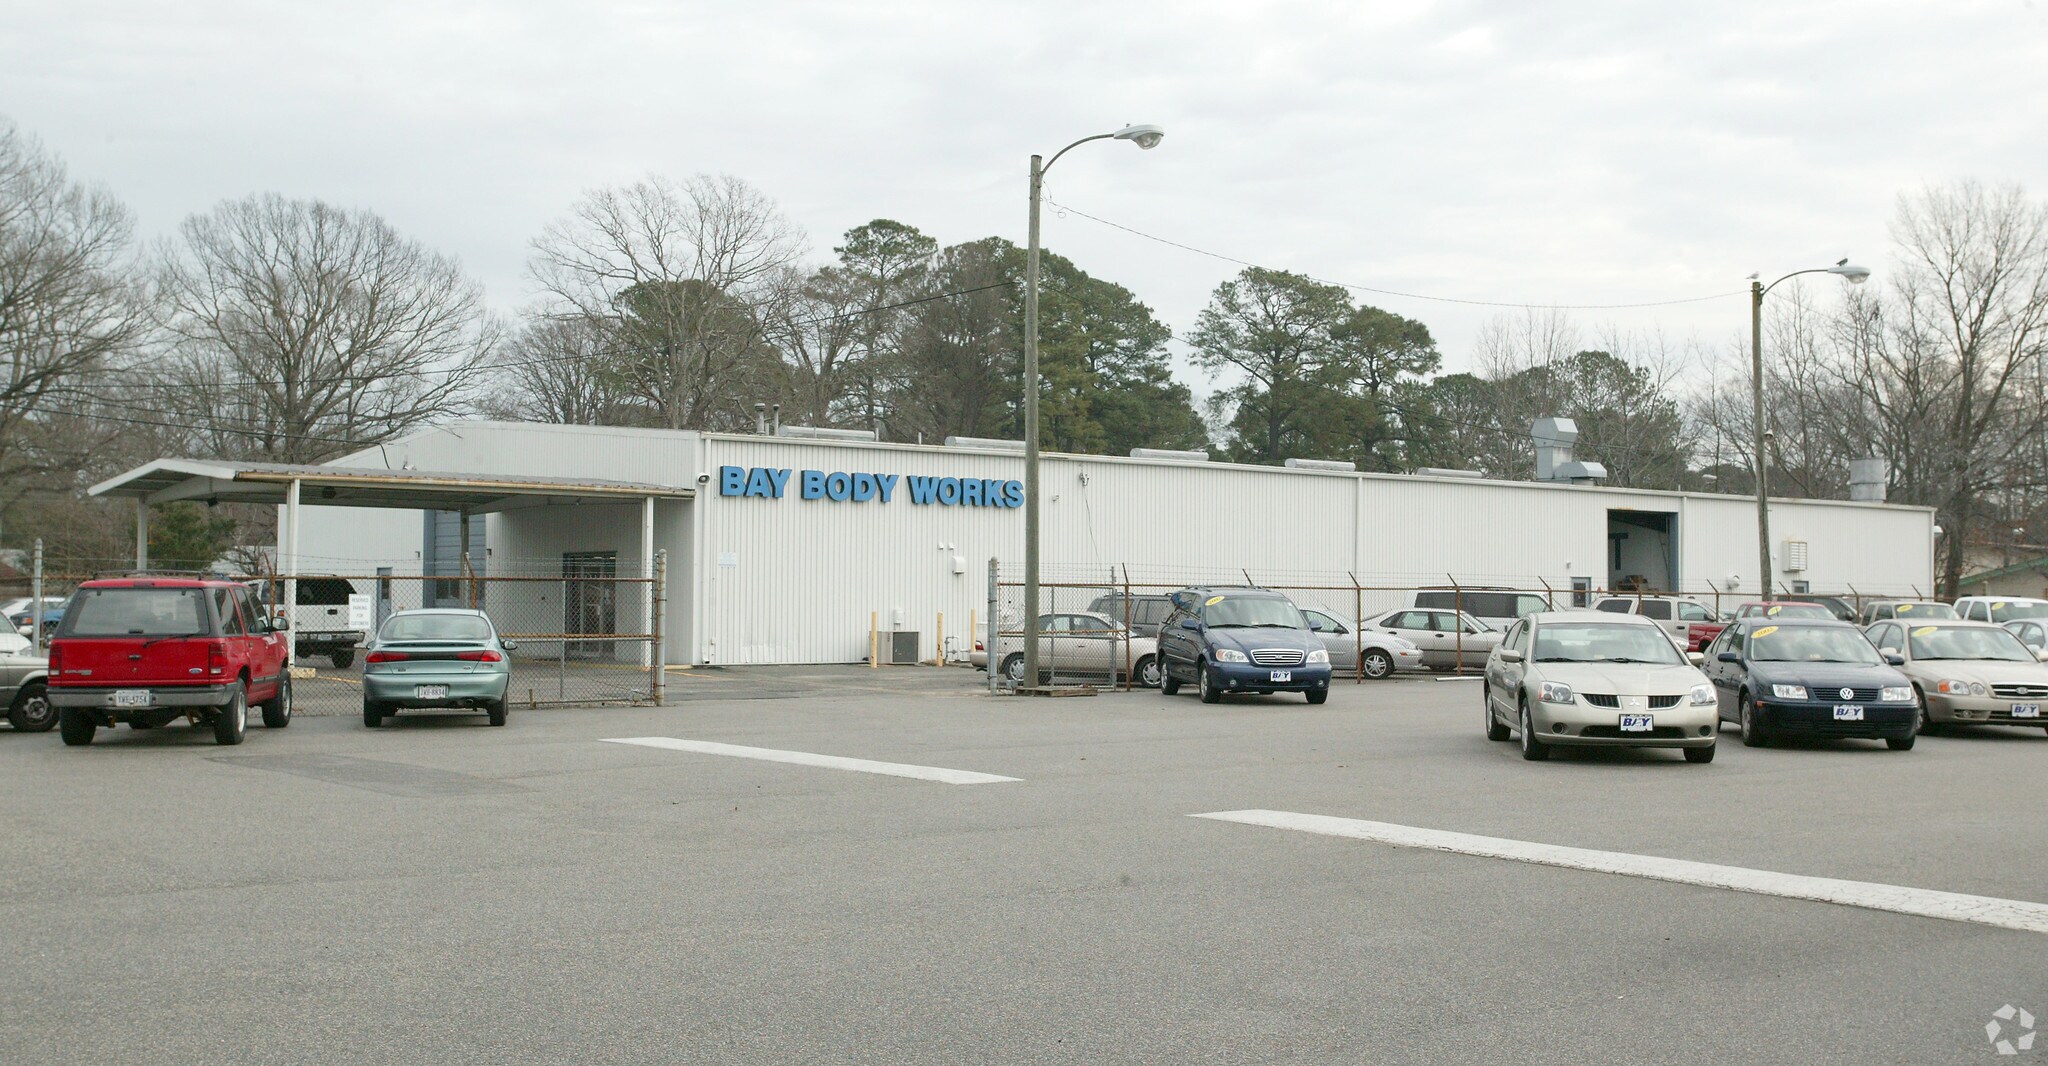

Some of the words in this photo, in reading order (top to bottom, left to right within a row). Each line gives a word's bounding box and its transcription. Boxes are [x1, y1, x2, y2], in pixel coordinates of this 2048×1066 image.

[720, 465, 792, 498] BAY
[801, 470, 899, 503] BODY
[907, 475, 1025, 508] WORKS
